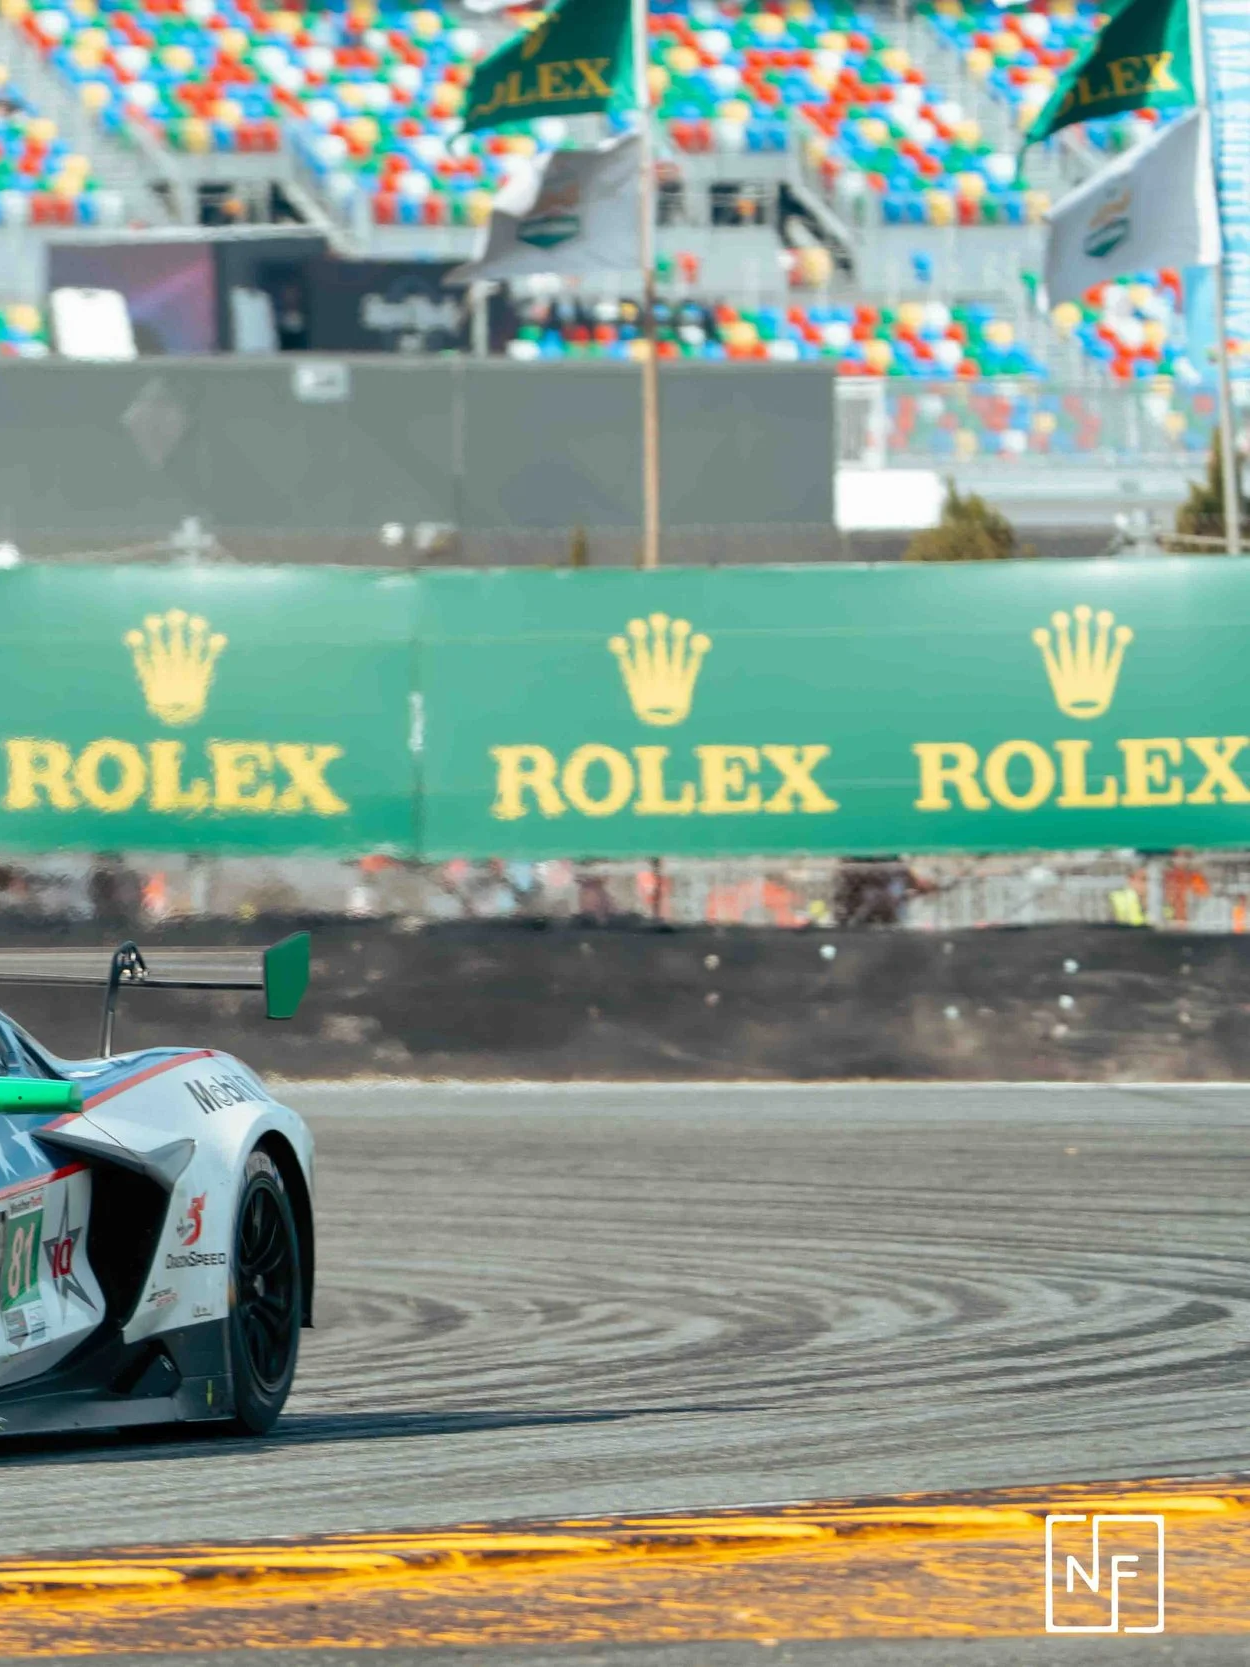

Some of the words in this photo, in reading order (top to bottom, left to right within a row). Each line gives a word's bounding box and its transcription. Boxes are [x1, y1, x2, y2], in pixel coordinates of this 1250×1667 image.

[1, 737, 348, 815] ROLEX
[490, 743, 839, 820] ROLEX
[912, 736, 1250, 810] ROLEX
[8, 1222, 36, 1299] 81
